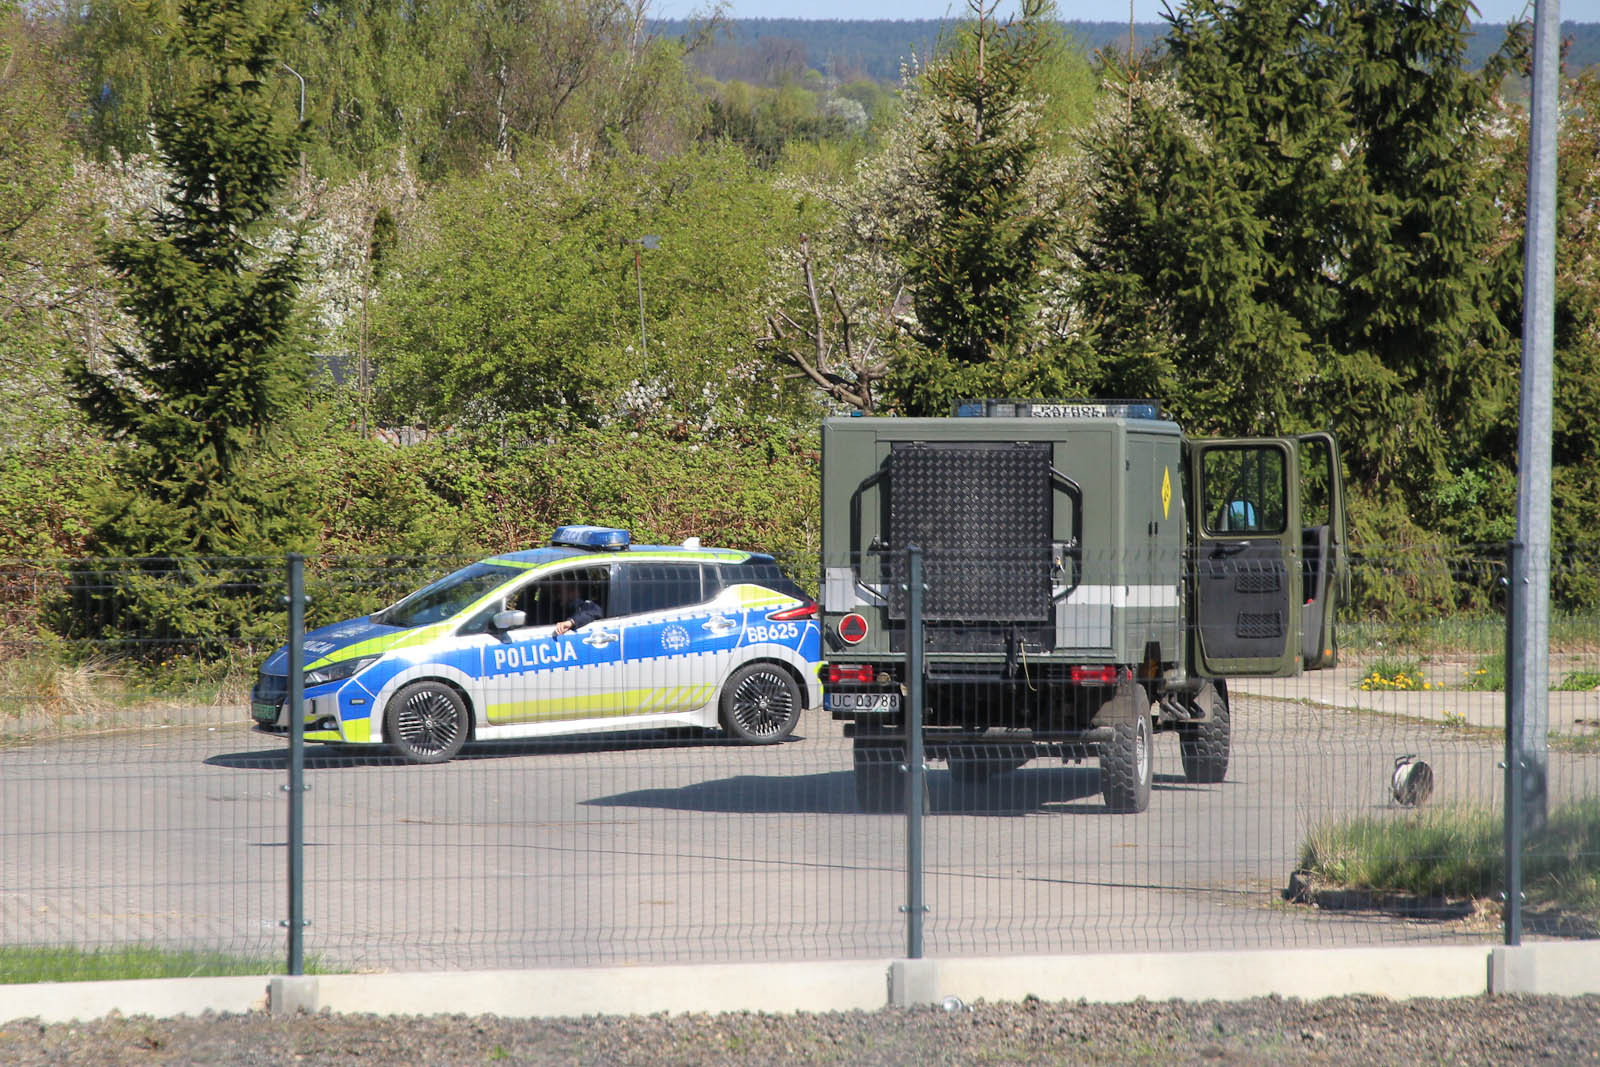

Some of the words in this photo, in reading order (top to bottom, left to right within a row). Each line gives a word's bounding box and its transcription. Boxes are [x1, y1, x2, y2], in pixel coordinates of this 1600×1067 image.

[746, 622, 799, 643] BB625
[494, 640, 578, 670] POLICJA
[832, 695, 851, 708] UC
[856, 695, 897, 708] 03788
